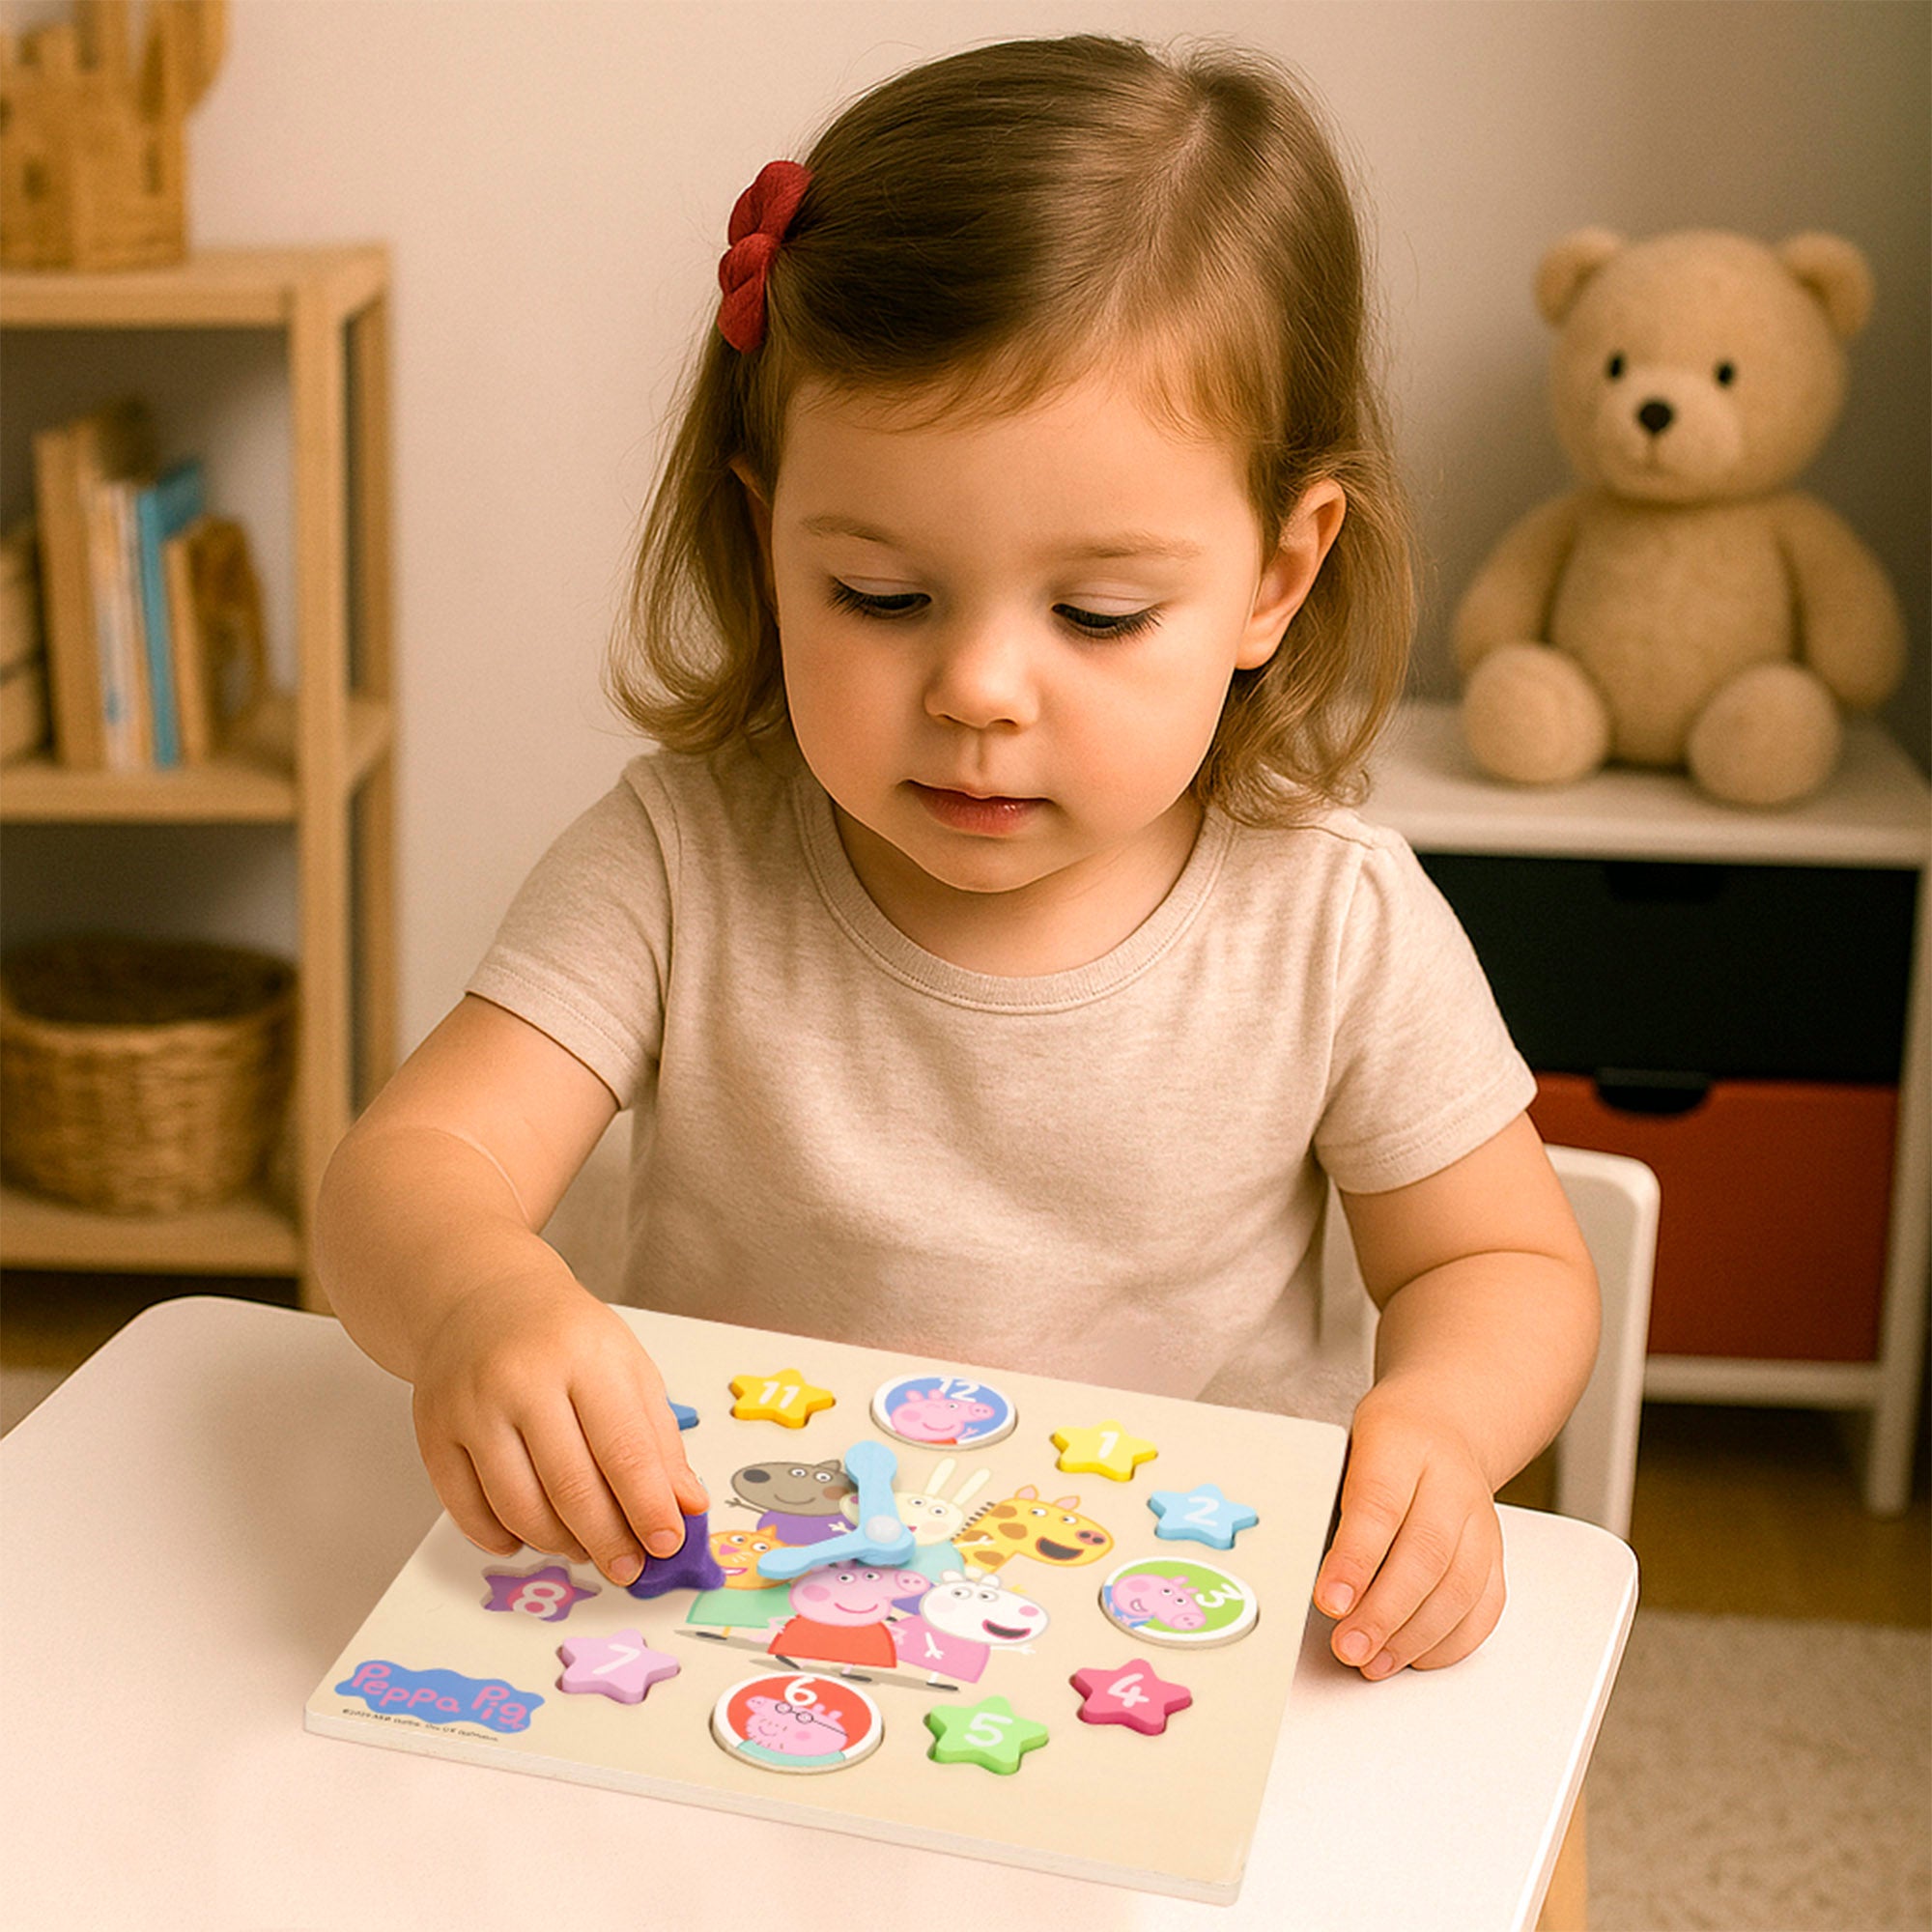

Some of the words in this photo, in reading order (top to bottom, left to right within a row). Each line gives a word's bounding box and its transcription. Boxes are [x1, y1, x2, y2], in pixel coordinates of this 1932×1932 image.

[757, 1381, 800, 1409] 11
[939, 1376, 980, 1403] 12
[1098, 1431, 1119, 1459] 1
[1185, 1497, 1220, 1525] 2
[512, 1582, 566, 1619] 8
[1195, 1582, 1243, 1608] 3
[592, 1643, 640, 1675] 7
[351, 1662, 461, 1714] Peppa
[470, 1685, 527, 1729] Pig
[783, 1676, 818, 1706] 6
[1108, 1673, 1150, 1708] 4
[966, 1713, 1012, 1747] 5
